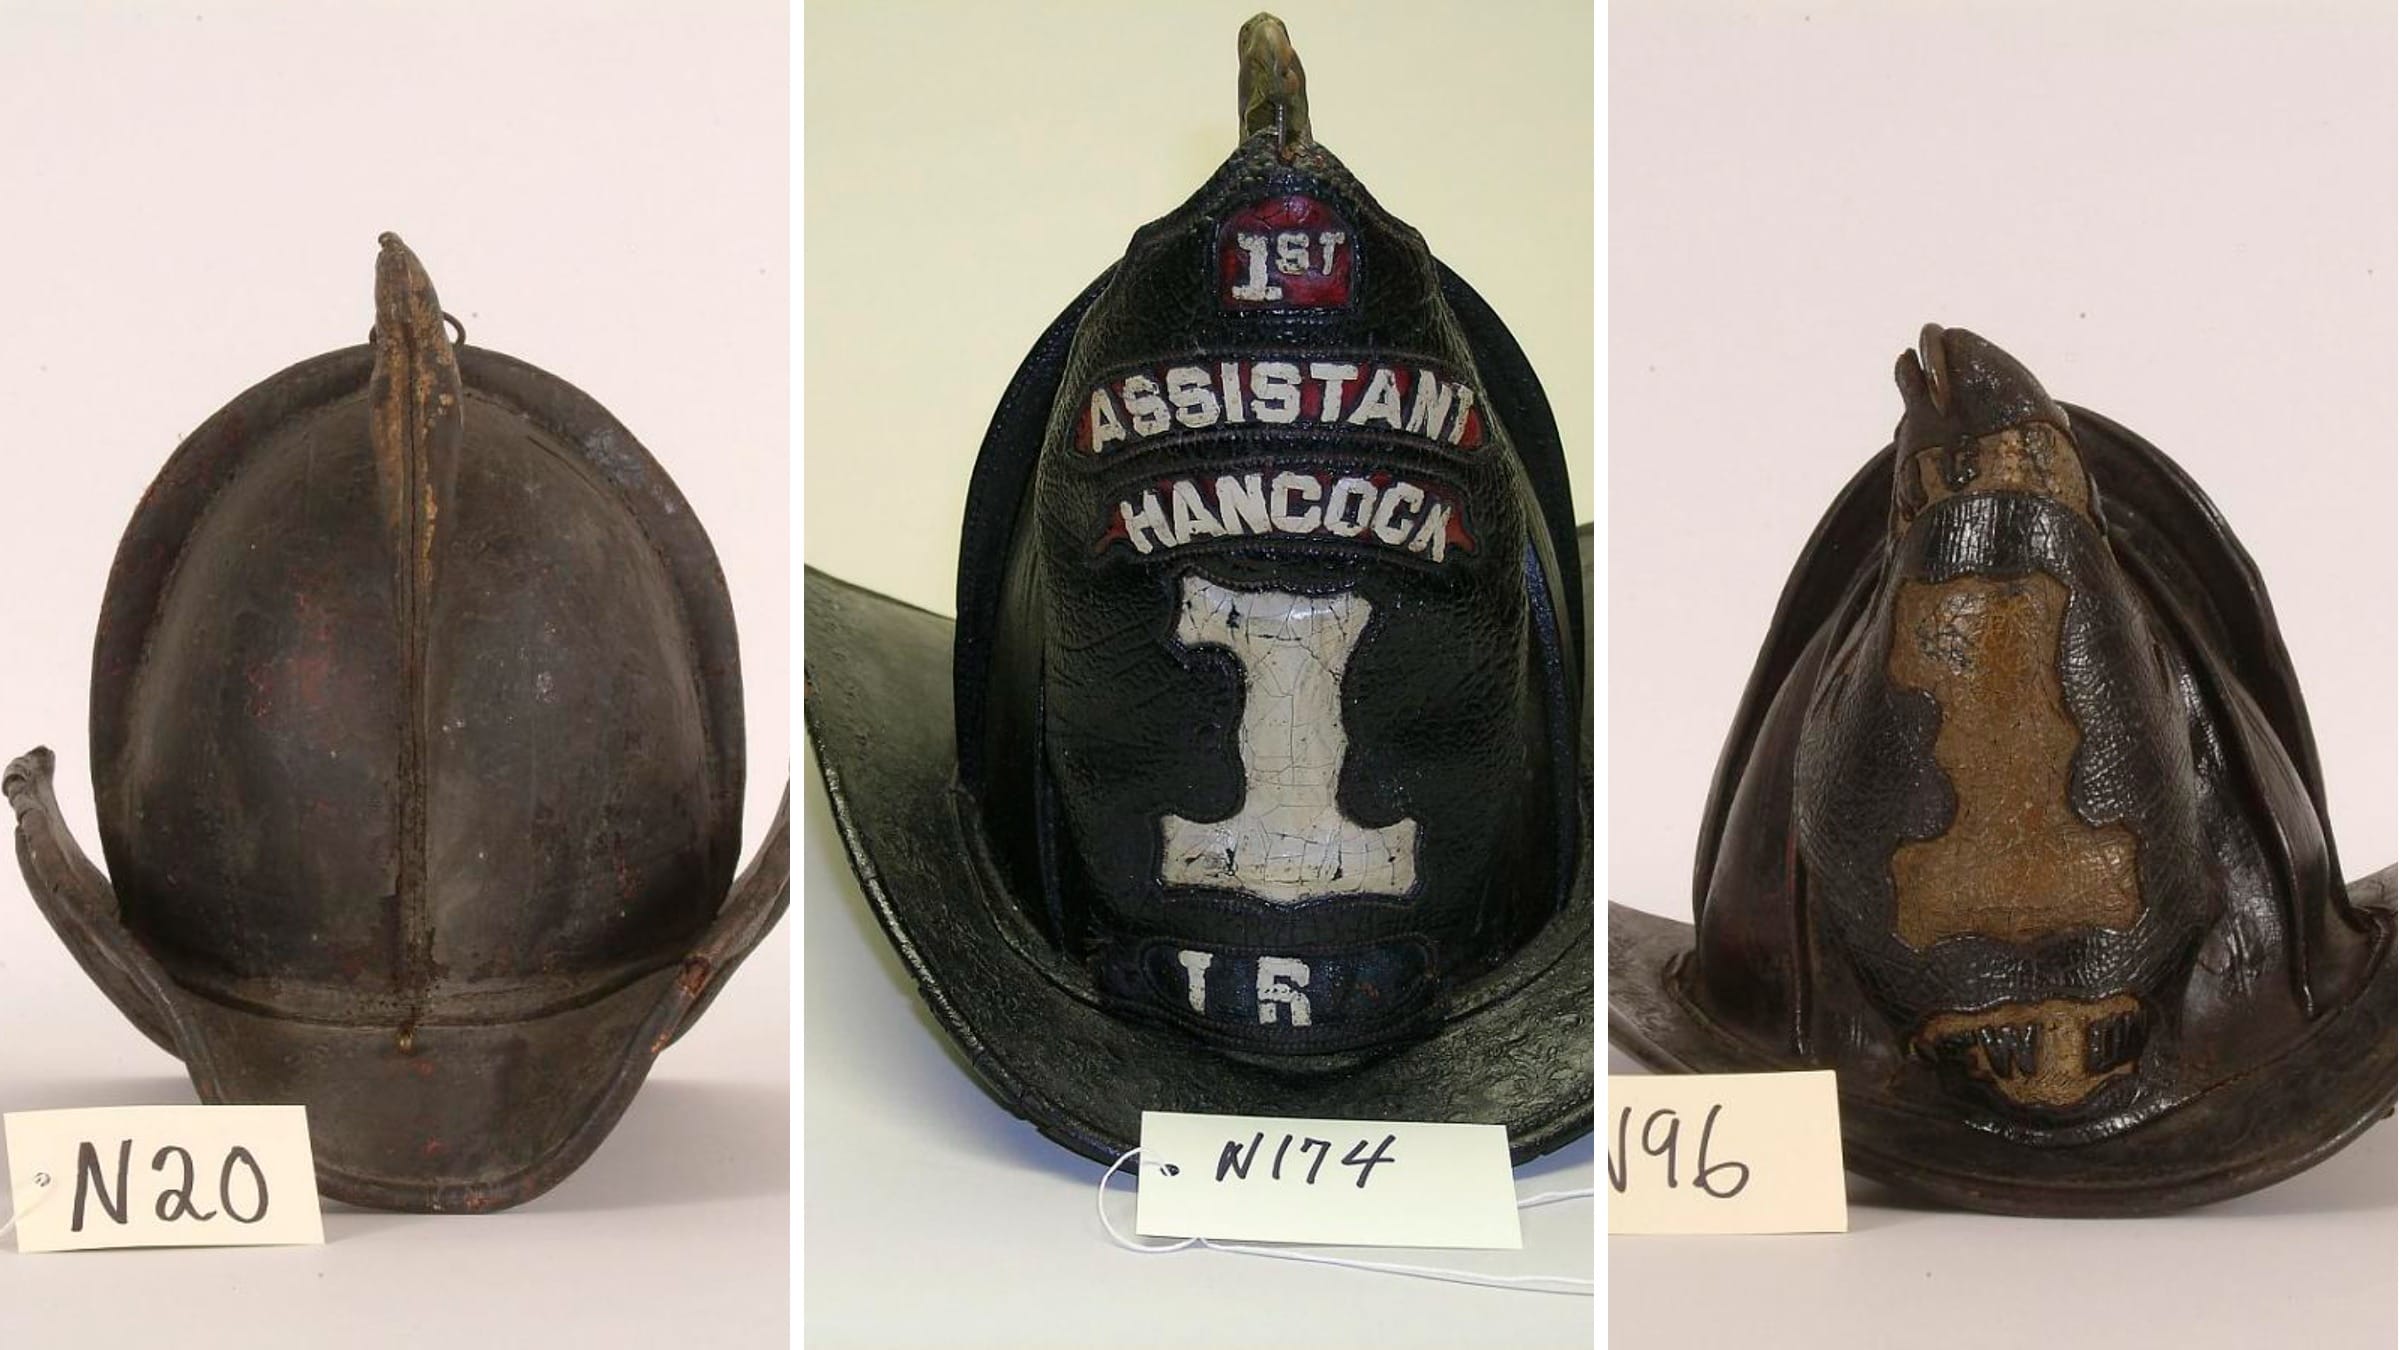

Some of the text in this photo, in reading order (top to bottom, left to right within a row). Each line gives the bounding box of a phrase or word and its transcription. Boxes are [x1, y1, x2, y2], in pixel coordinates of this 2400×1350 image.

[1231, 231, 1346, 302] 1ST
[1090, 361, 1474, 453] ASSISTANT
[1118, 470, 1452, 563] HANCOCK
[1160, 574, 1418, 901] 1
[71, 1139, 270, 1233] N20
[1216, 1131, 1397, 1189] N174
